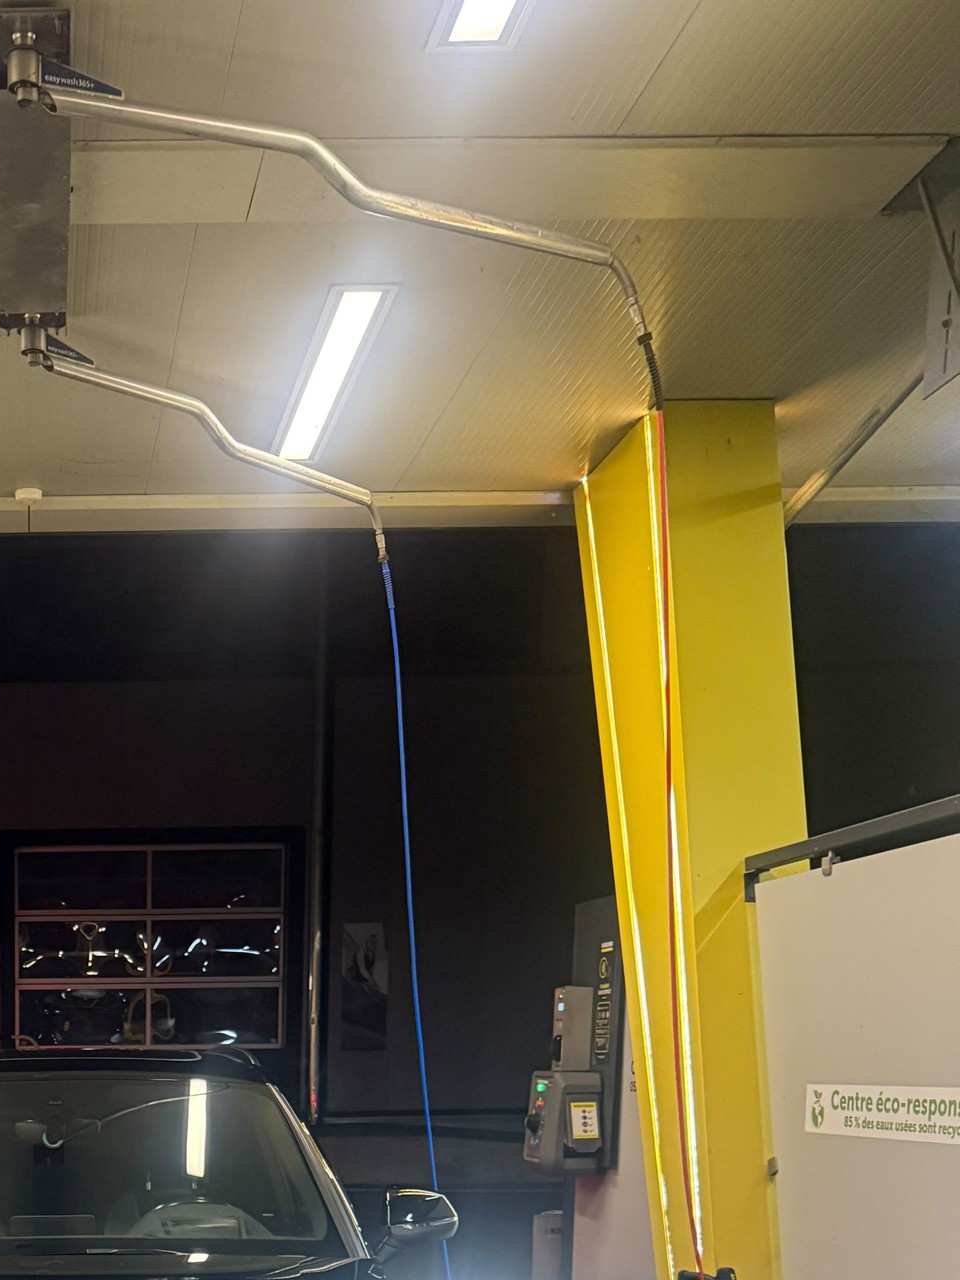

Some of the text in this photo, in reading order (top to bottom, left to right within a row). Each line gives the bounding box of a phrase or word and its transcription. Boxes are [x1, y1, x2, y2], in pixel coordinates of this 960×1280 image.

[831, 1089, 873, 1112] Centre
[844, 1115, 853, 1127] 85
[854, 1116, 860, 1129] %
[861, 1117, 875, 1130] des
[876, 1120, 893, 1131] eaux
[895, 1119, 917, 1132] usées
[918, 1122, 937, 1134] sont
